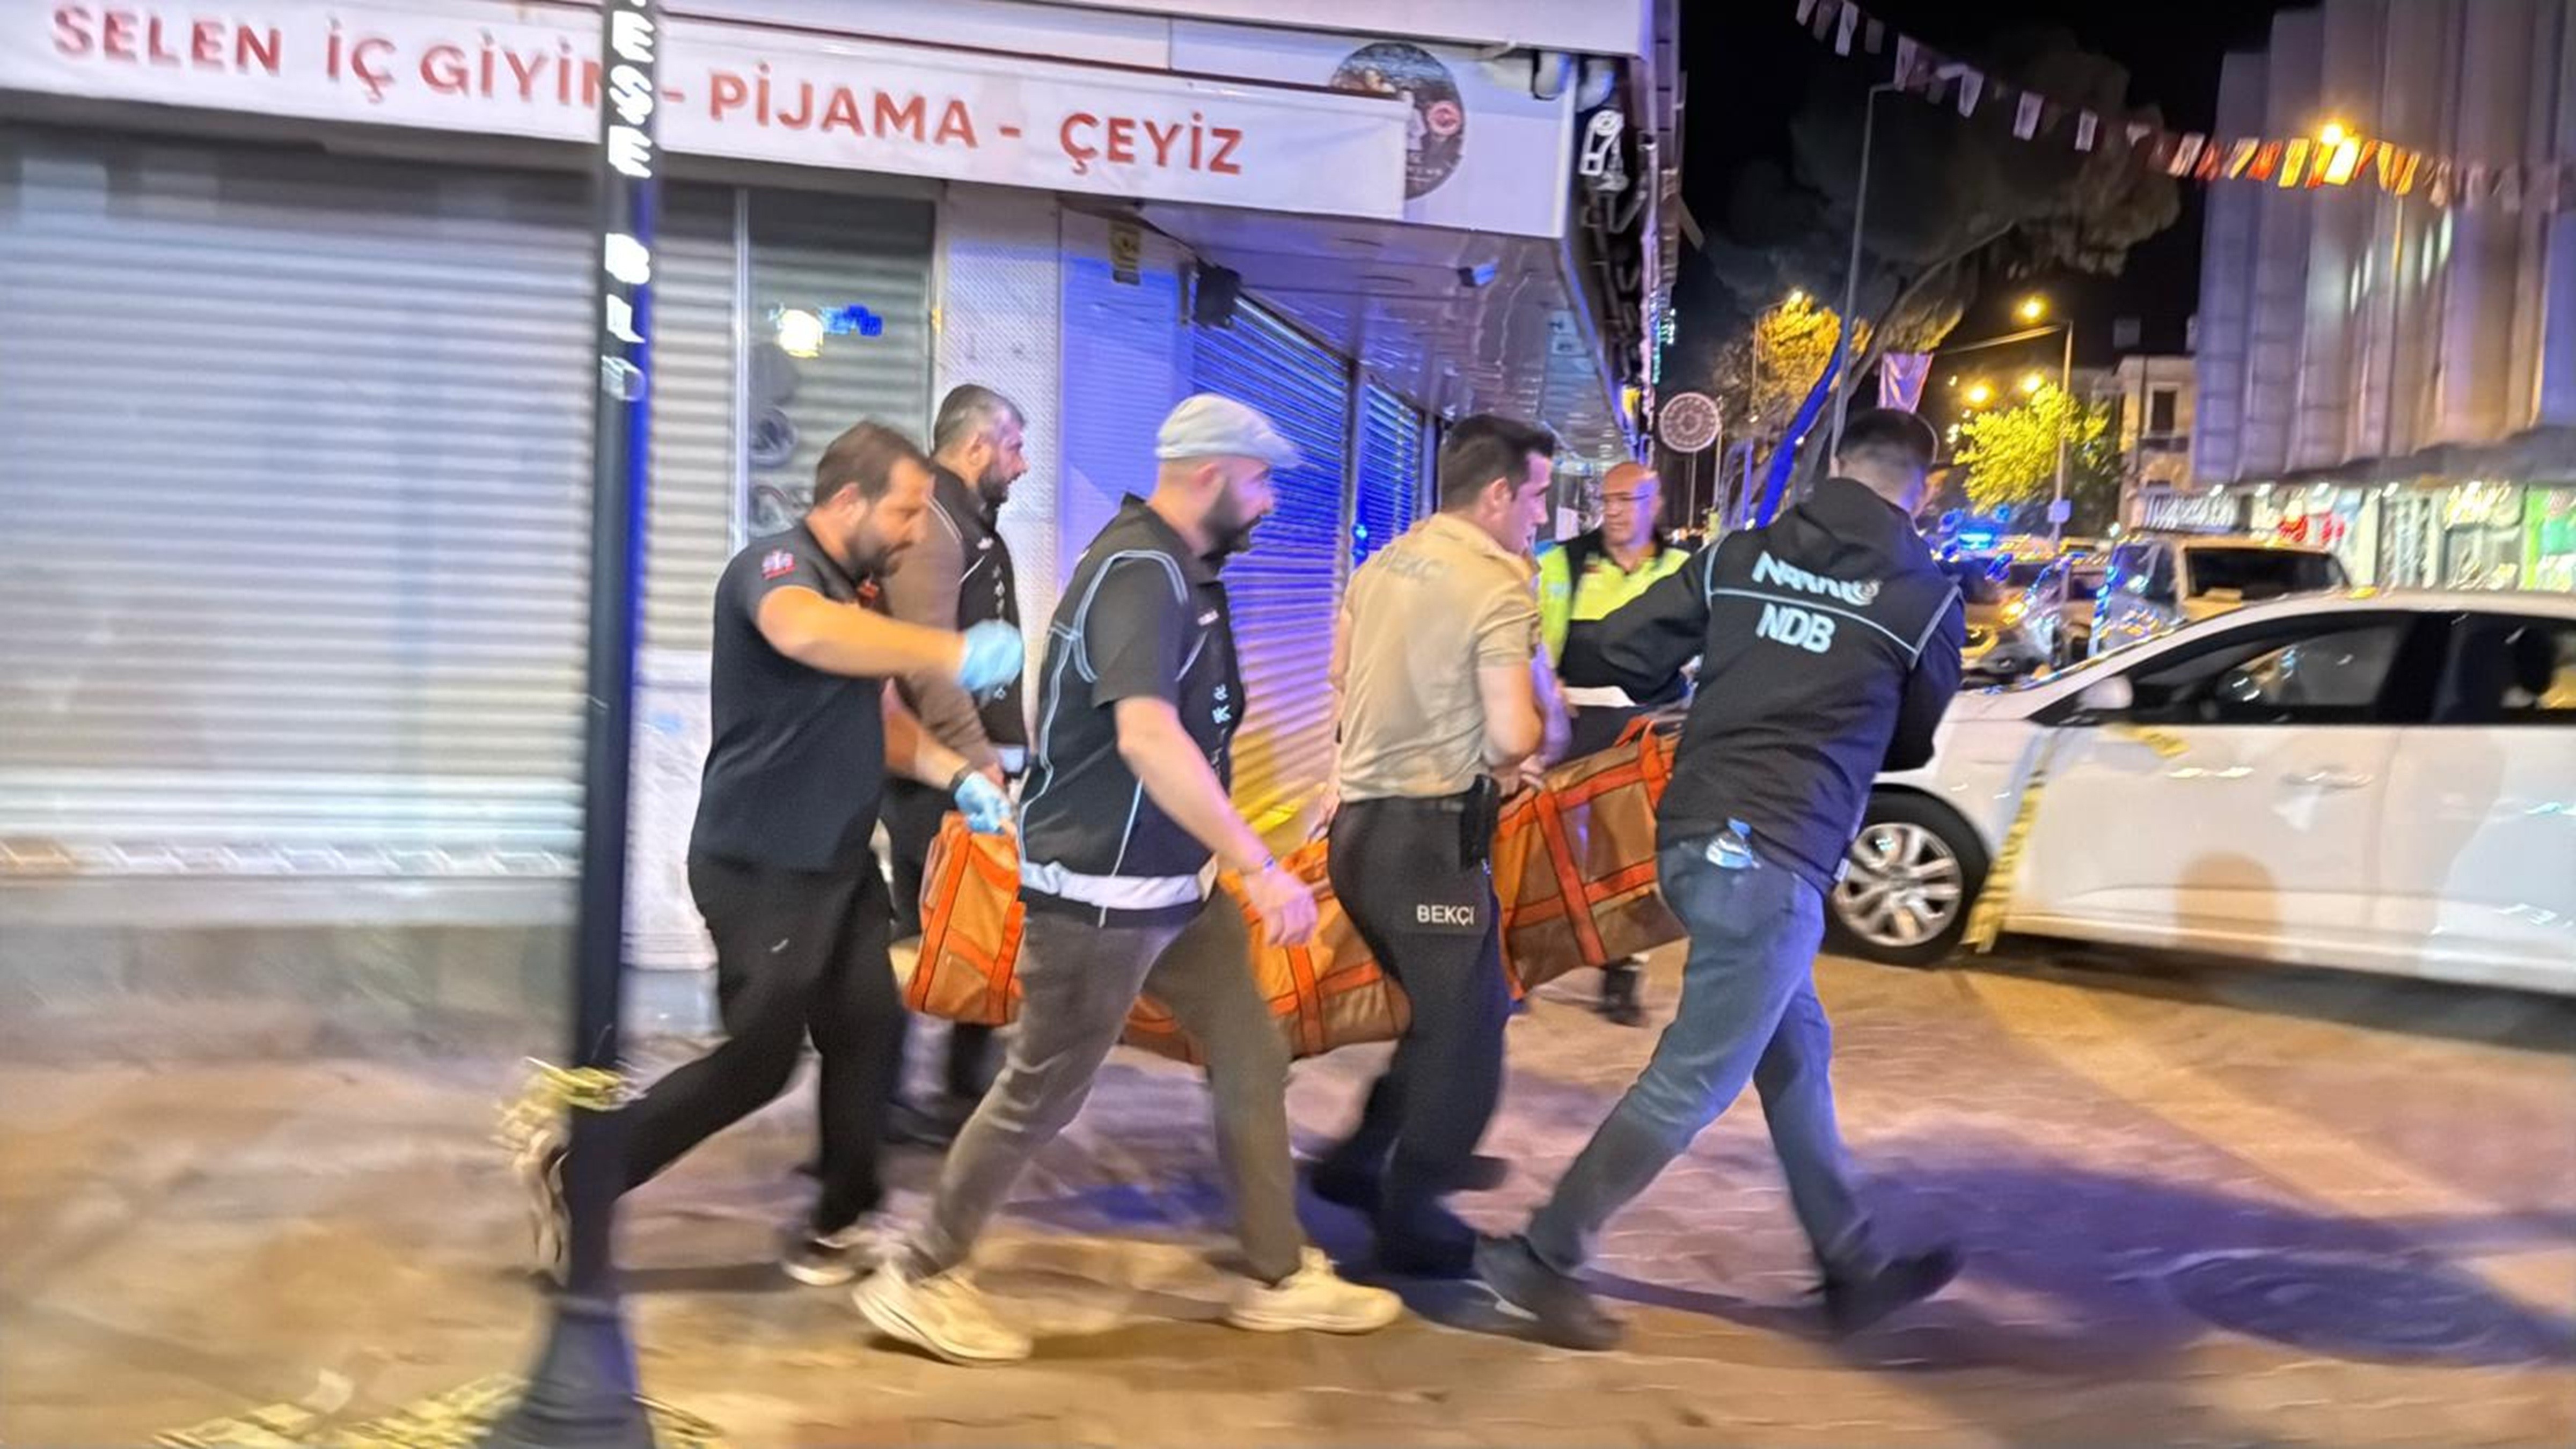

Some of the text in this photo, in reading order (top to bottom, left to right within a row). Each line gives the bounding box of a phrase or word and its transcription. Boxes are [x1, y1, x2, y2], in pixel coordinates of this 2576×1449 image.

[55, 6, 281, 76] SELEN
[326, 14, 398, 104] İÇ
[709, 63, 979, 149] PİJAMA
[1059, 112, 1243, 176] ÇEYİZ
[1755, 602, 1836, 654] NDB
